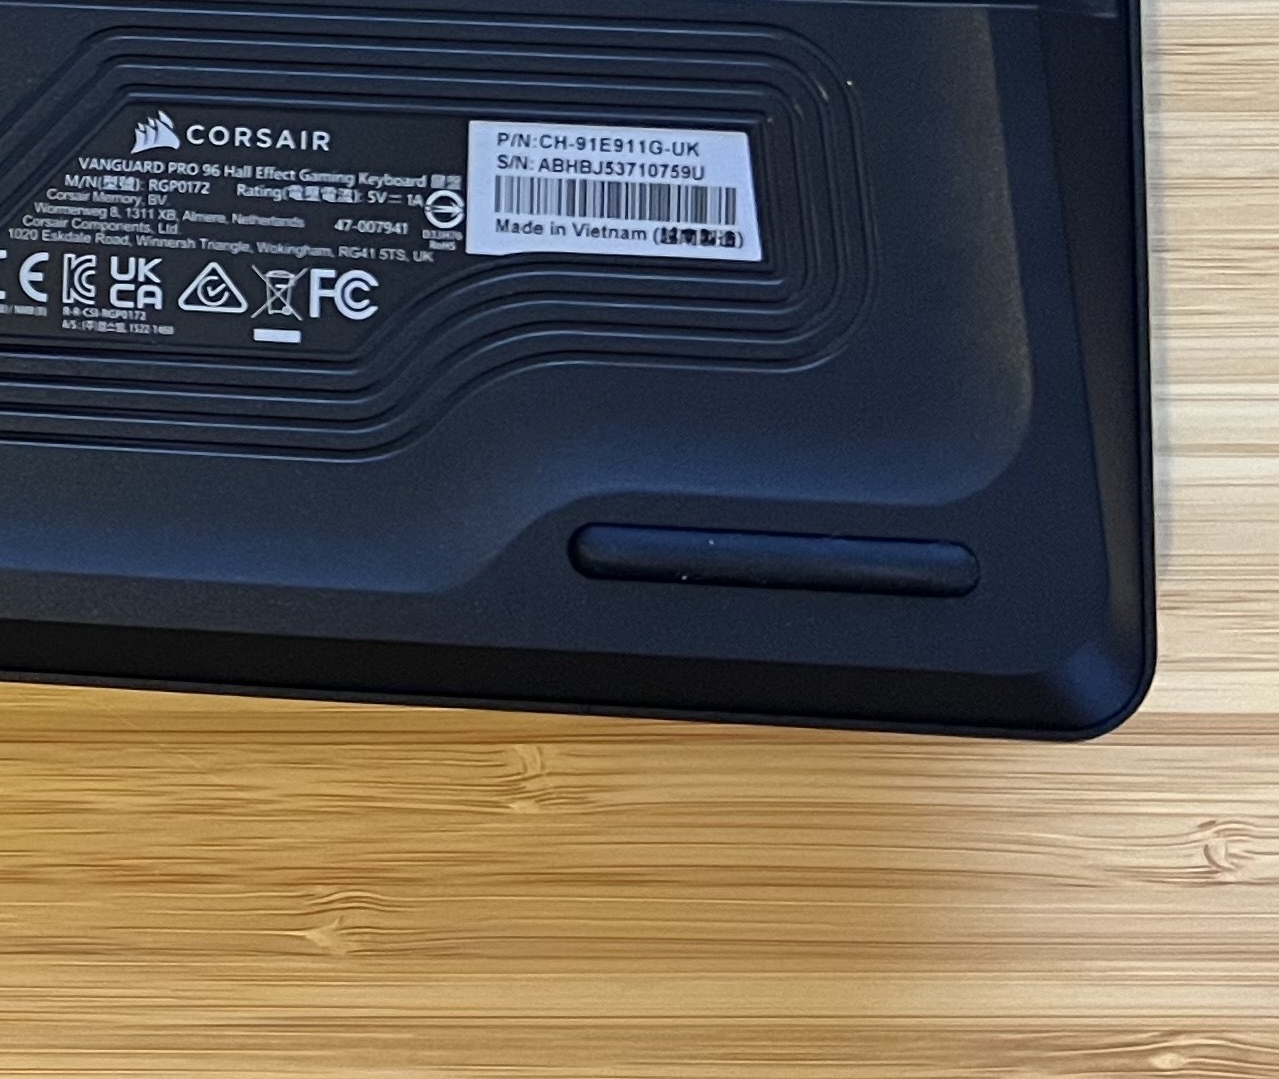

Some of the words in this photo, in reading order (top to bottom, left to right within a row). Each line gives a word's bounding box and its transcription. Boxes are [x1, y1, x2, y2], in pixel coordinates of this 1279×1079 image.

[186, 124, 331, 152] CORSAIR
[78, 156, 165, 175] VANGUARD
[168, 161, 198, 176] PRO
[202, 163, 221, 177] 96
[224, 165, 253, 179] Hall
[255, 166, 296, 182] Effect
[299, 168, 356, 187] Gaming
[358, 171, 428, 189] Keyboard
[496, 155, 534, 171] S/N:
[46, 187, 91, 203] Corsair
[148, 178, 211, 196] RGP0172
[407, 193, 425, 208] 1A
[22, 214, 70, 229] Corsair
[126, 206, 155, 220] 1311
[334, 219, 409, 236] 47-007941
[495, 218, 544, 236] Made
[550, 221, 567, 237] in
[571, 222, 647, 241] Vietnam
[8, 227, 39, 242] 1020
[41, 229, 92, 244] Eskdale
[94, 232, 133, 248] Road,
[135, 235, 196, 250] Winnersh
[412, 250, 435, 263] UK
[110, 256, 162, 283] UK
[109, 283, 163, 310] CA
